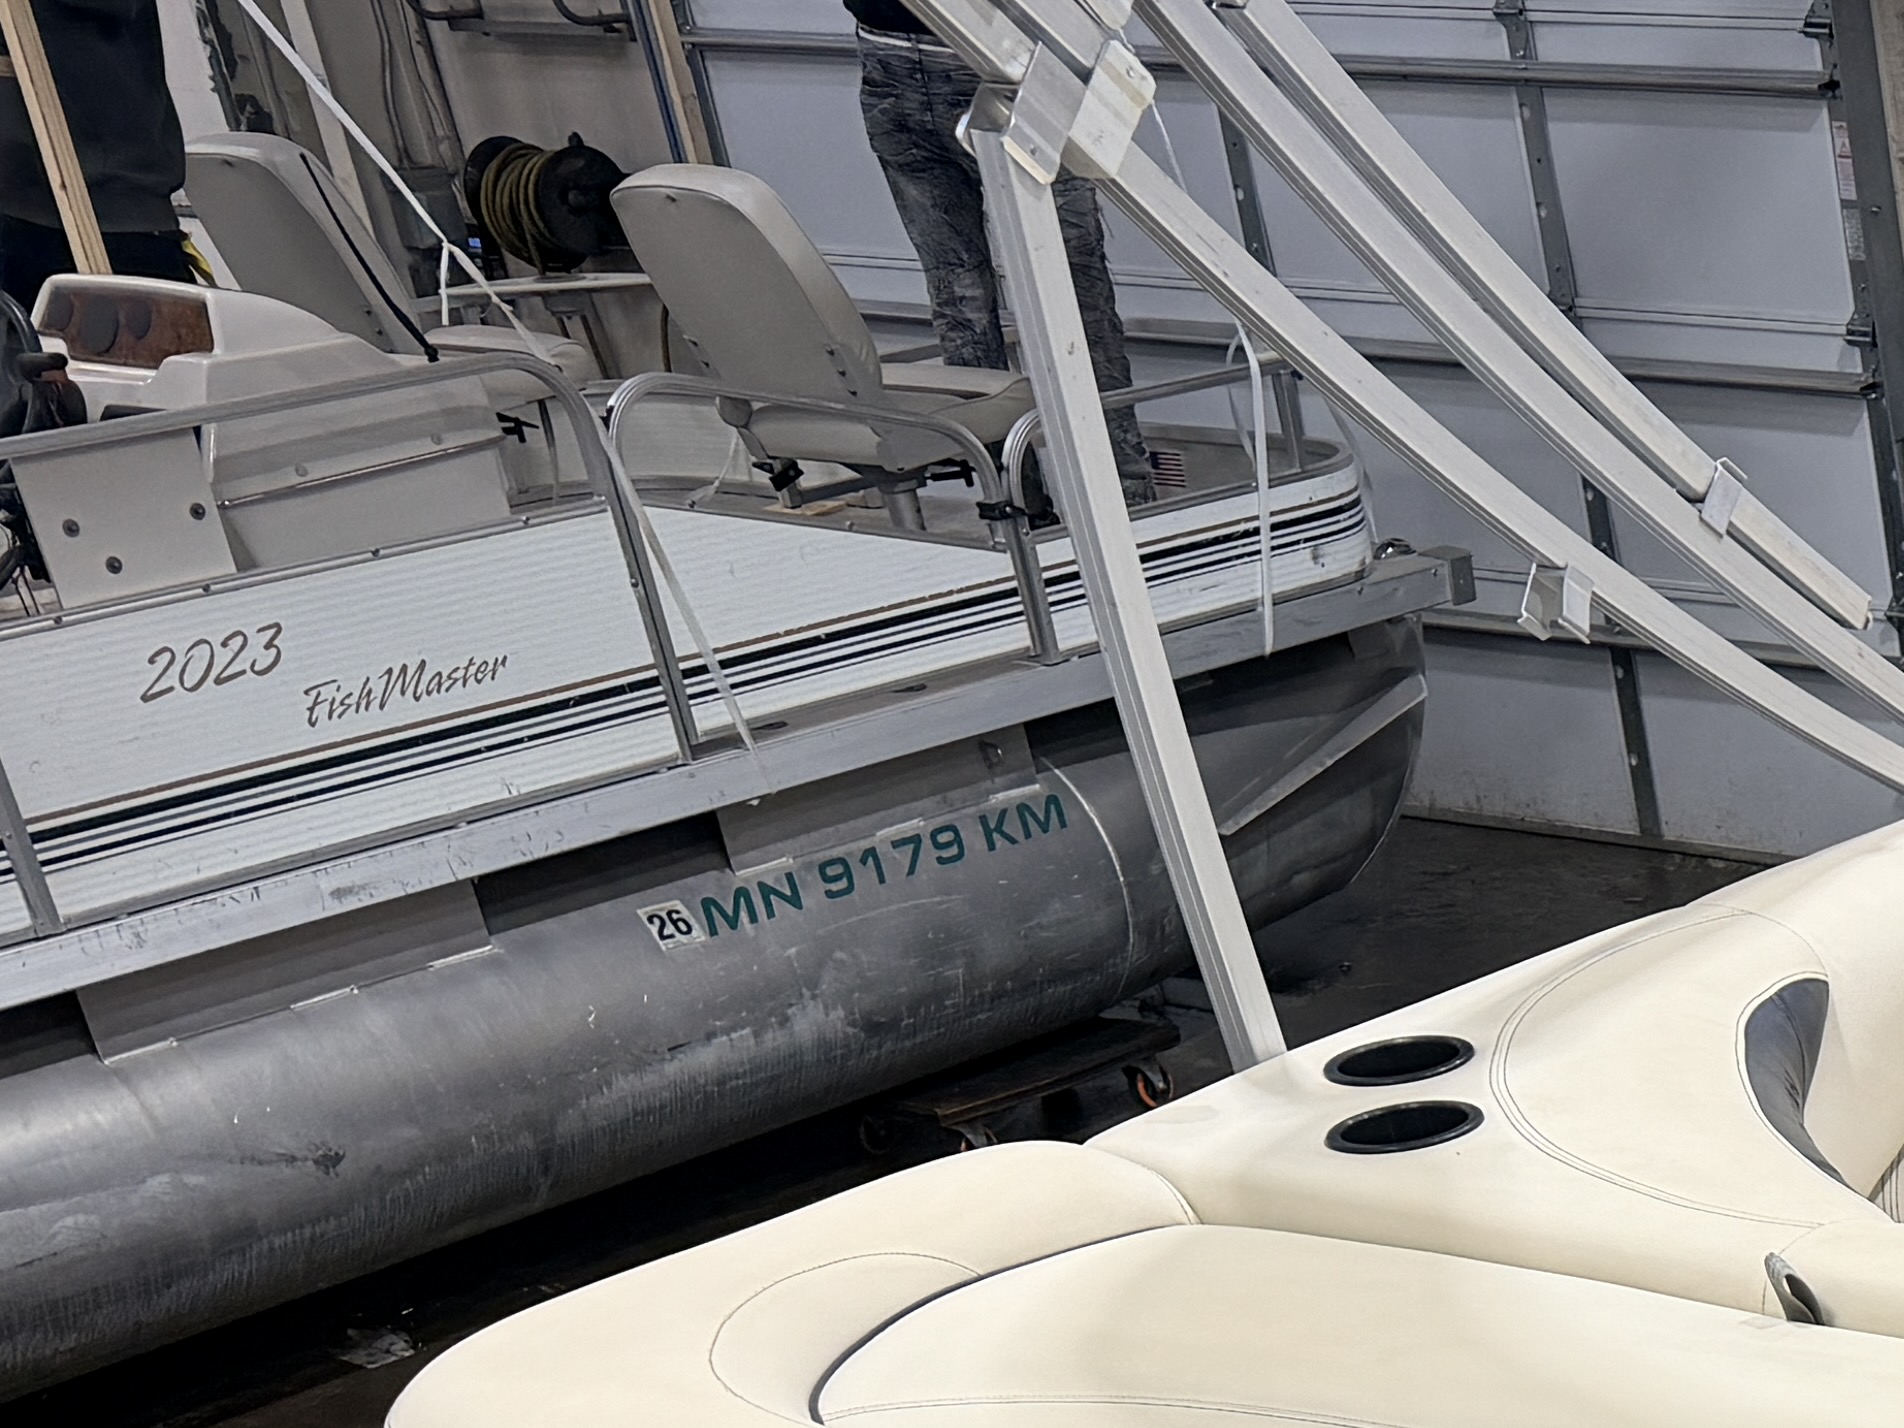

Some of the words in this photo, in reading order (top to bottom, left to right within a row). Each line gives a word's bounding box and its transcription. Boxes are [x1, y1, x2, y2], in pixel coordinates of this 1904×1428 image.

[139, 621, 283, 703] 2023
[303, 651, 510, 729] FishMaster
[647, 908, 694, 942] 26
[701, 871, 804, 936] MN
[818, 825, 966, 900] 9179
[979, 793, 1069, 853] KM
